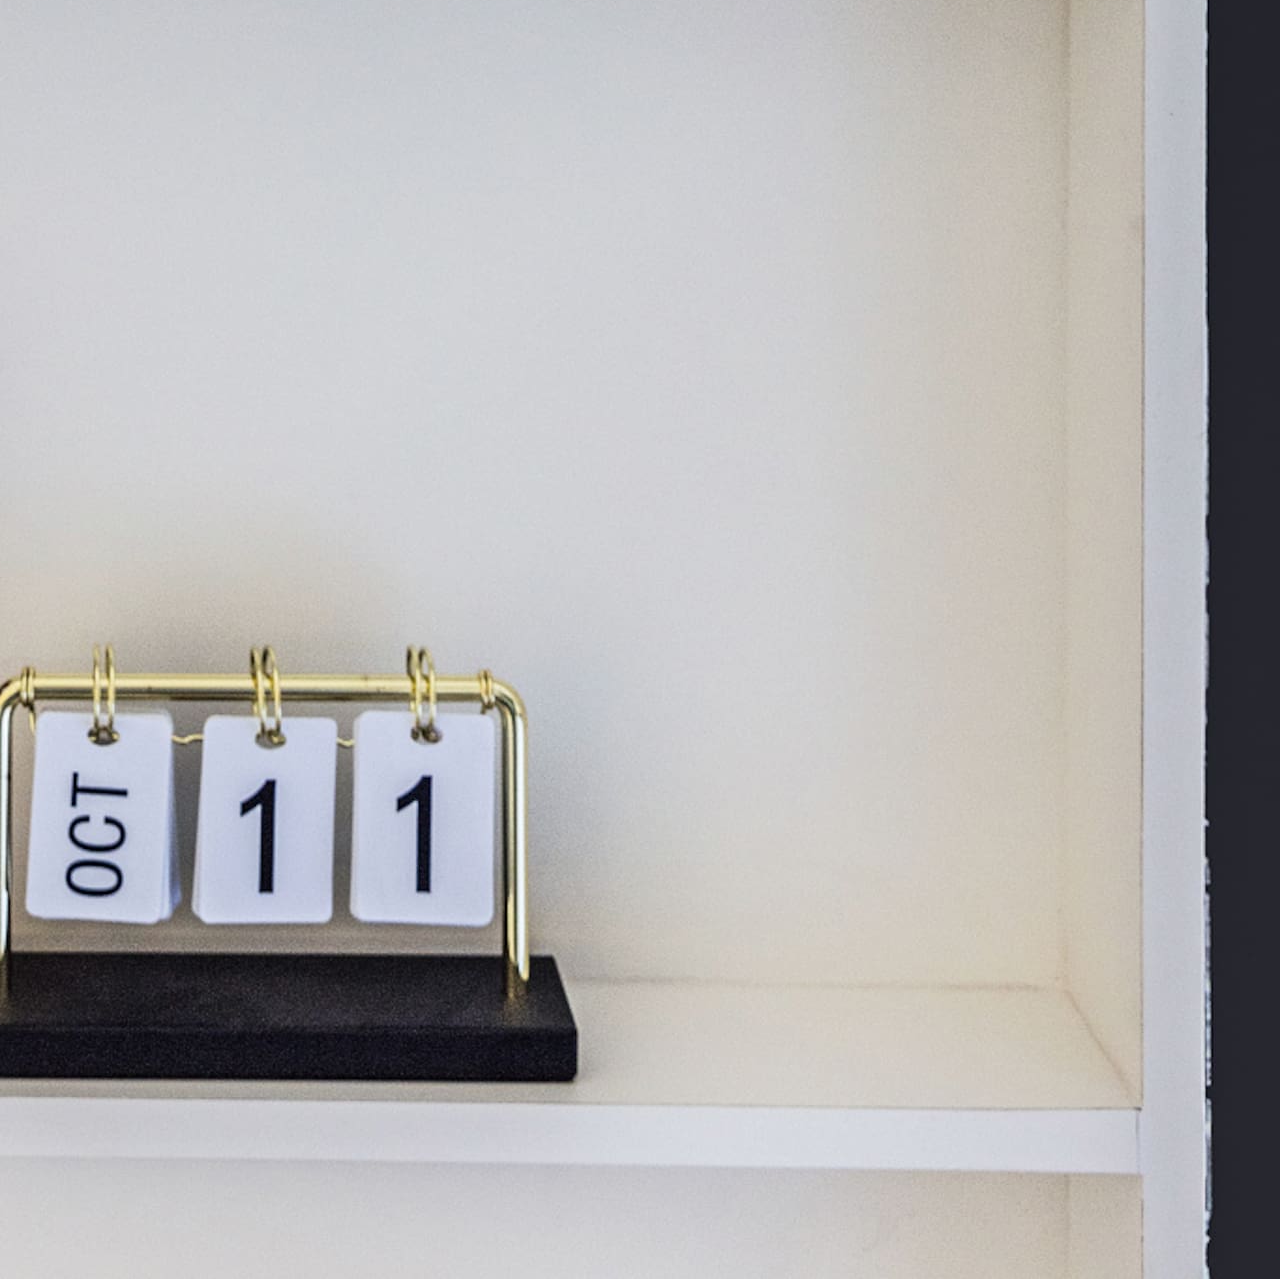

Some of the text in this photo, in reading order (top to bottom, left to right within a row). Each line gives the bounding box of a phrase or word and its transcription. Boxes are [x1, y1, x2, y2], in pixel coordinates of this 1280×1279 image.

[65, 771, 129, 898] OCT
[239, 778, 277, 894] 1
[395, 774, 433, 894] 1
